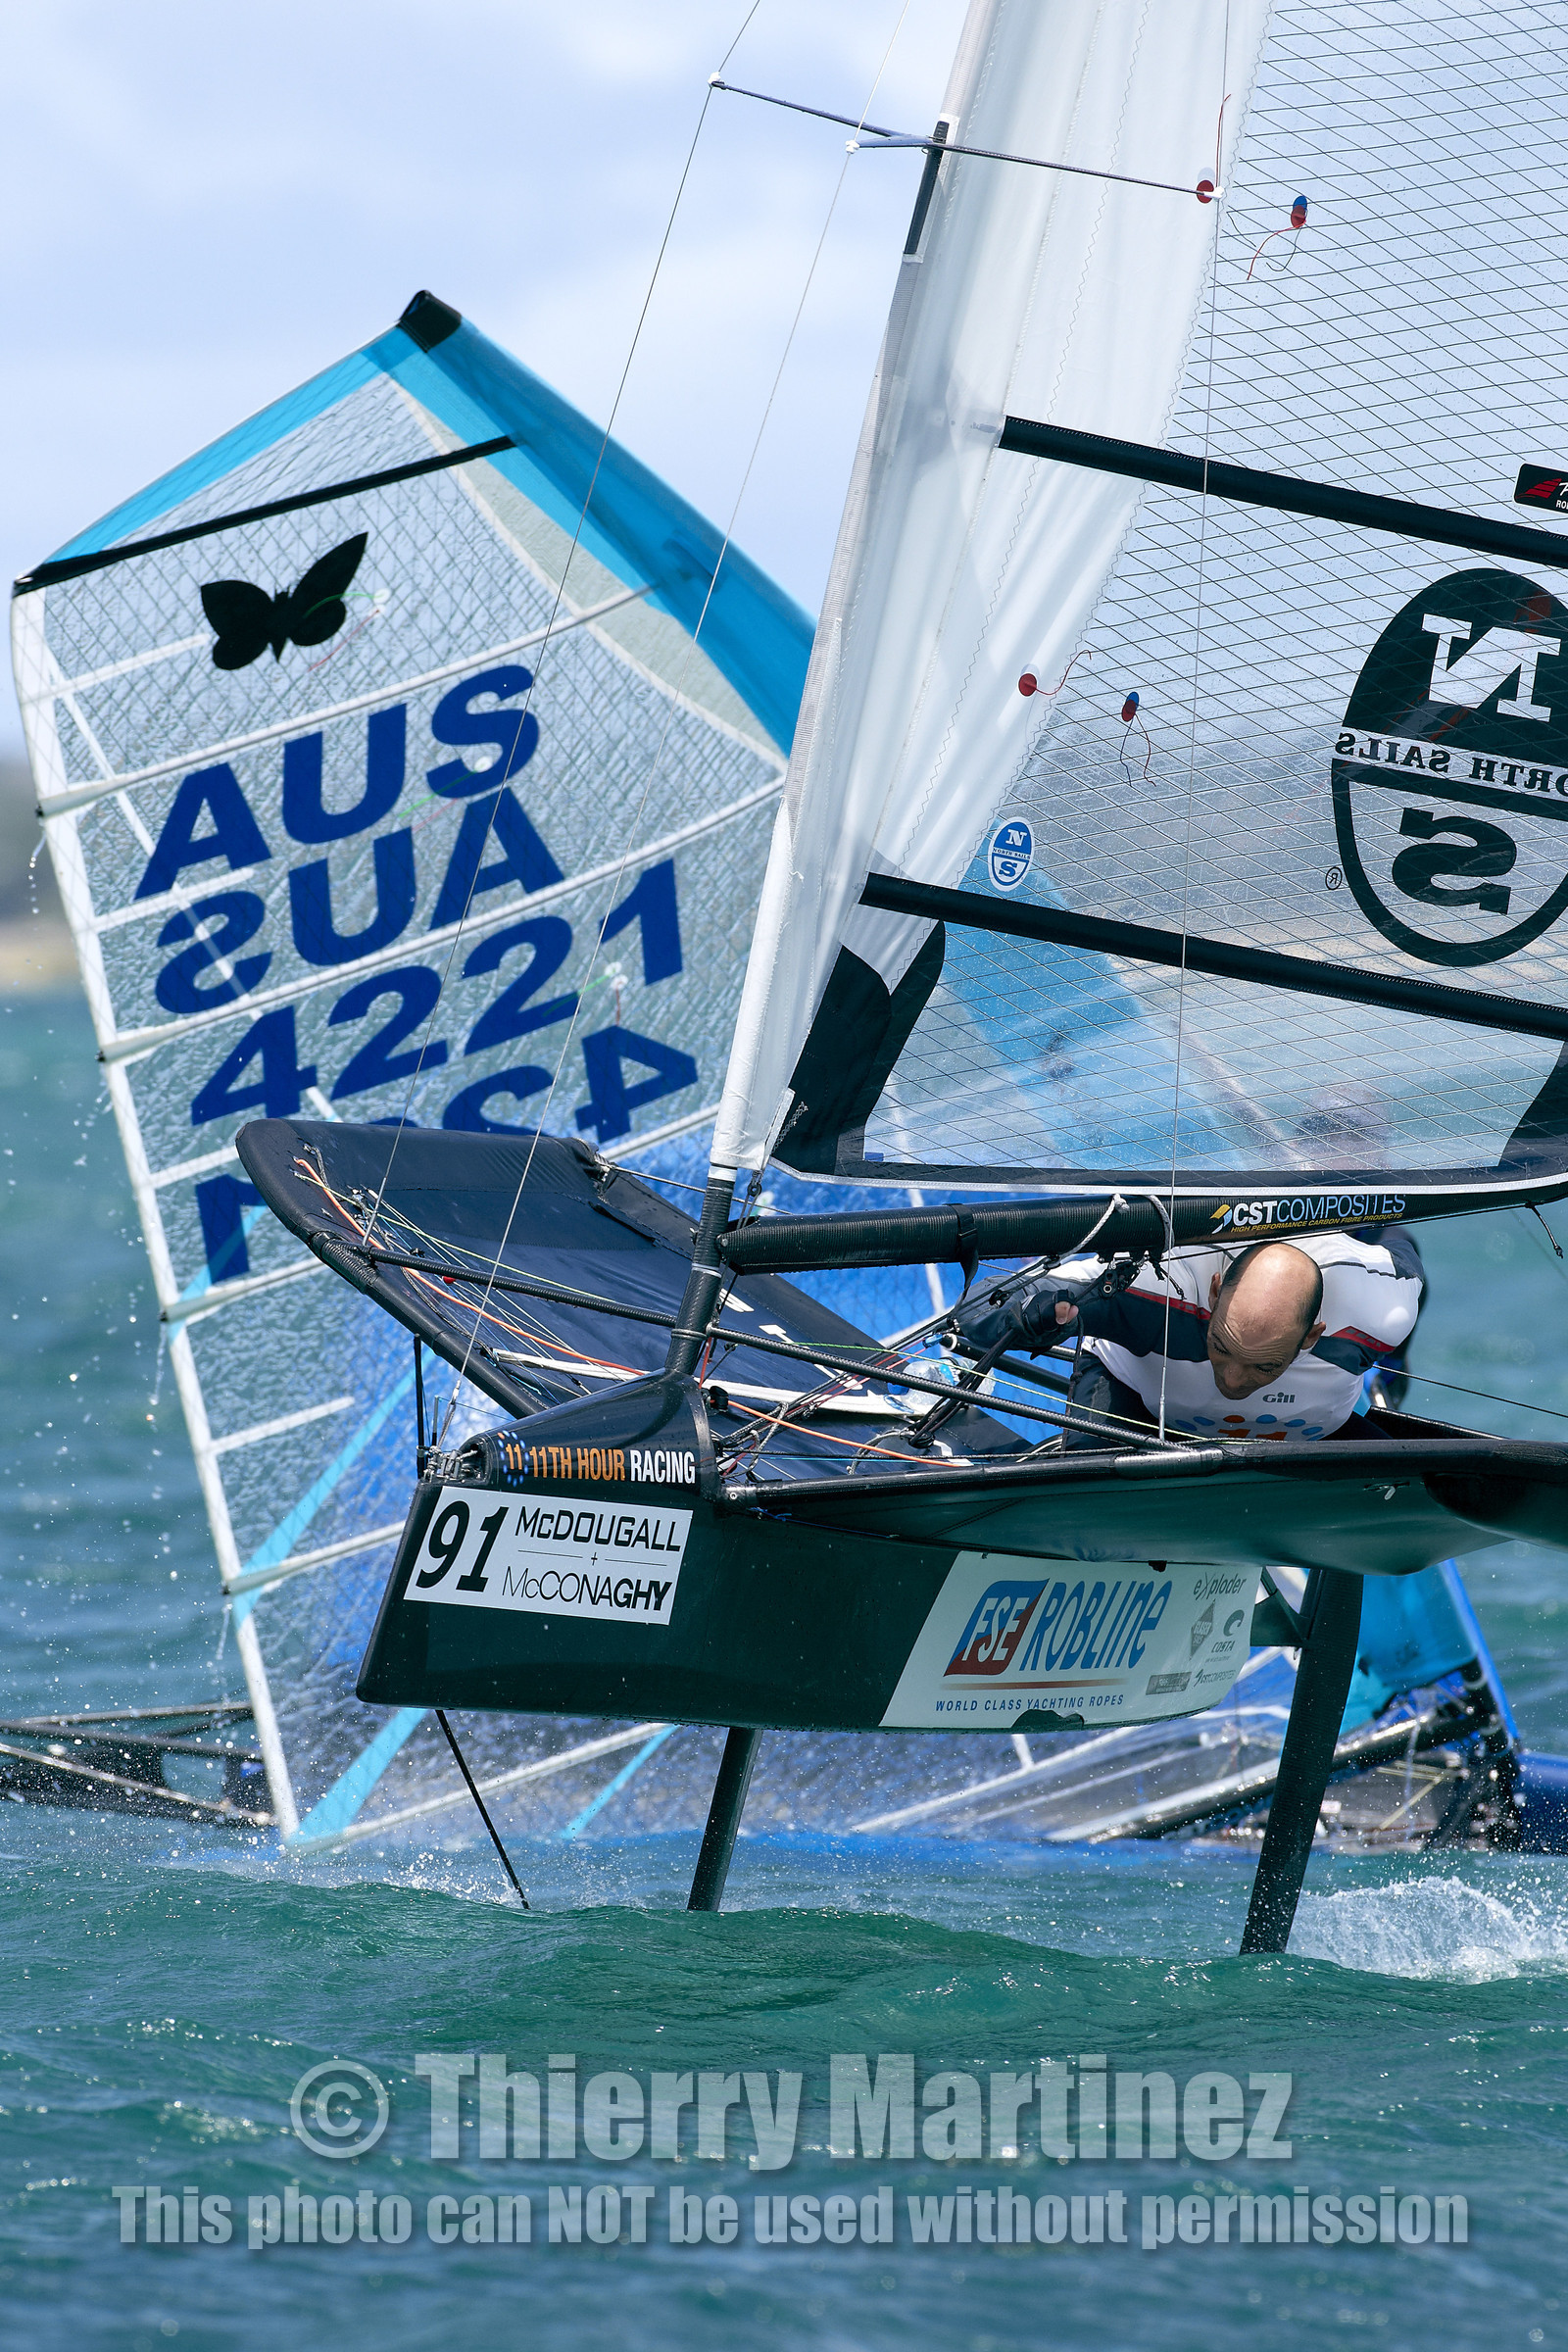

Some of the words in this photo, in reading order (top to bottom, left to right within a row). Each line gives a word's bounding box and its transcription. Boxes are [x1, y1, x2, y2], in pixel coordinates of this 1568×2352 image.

[132, 664, 541, 901] AUS
[1005, 829, 1027, 846] N
[999, 860, 1017, 877] S
[191, 860, 683, 1126] 4221
[1233, 1195, 1406, 1226] CSTCOMPOSITES
[1250, 1219, 1307, 1231] PERFORMANCE
[1308, 1216, 1339, 1226] CARBON
[1262, 1393, 1296, 1403] Gill
[506, 1443, 522, 1470] 11
[529, 1446, 572, 1479] 11TH
[576, 1448, 625, 1482] HOUR
[630, 1449, 696, 1484] RACING
[416, 1500, 509, 1592] 91
[961, 1596, 1030, 1662] FSE
[935, 1700, 978, 1712] WORLD
[984, 1699, 1022, 1711] CLASS
[1027, 1696, 1084, 1710] YACHTING
[1089, 1694, 1124, 1707] ROPES
